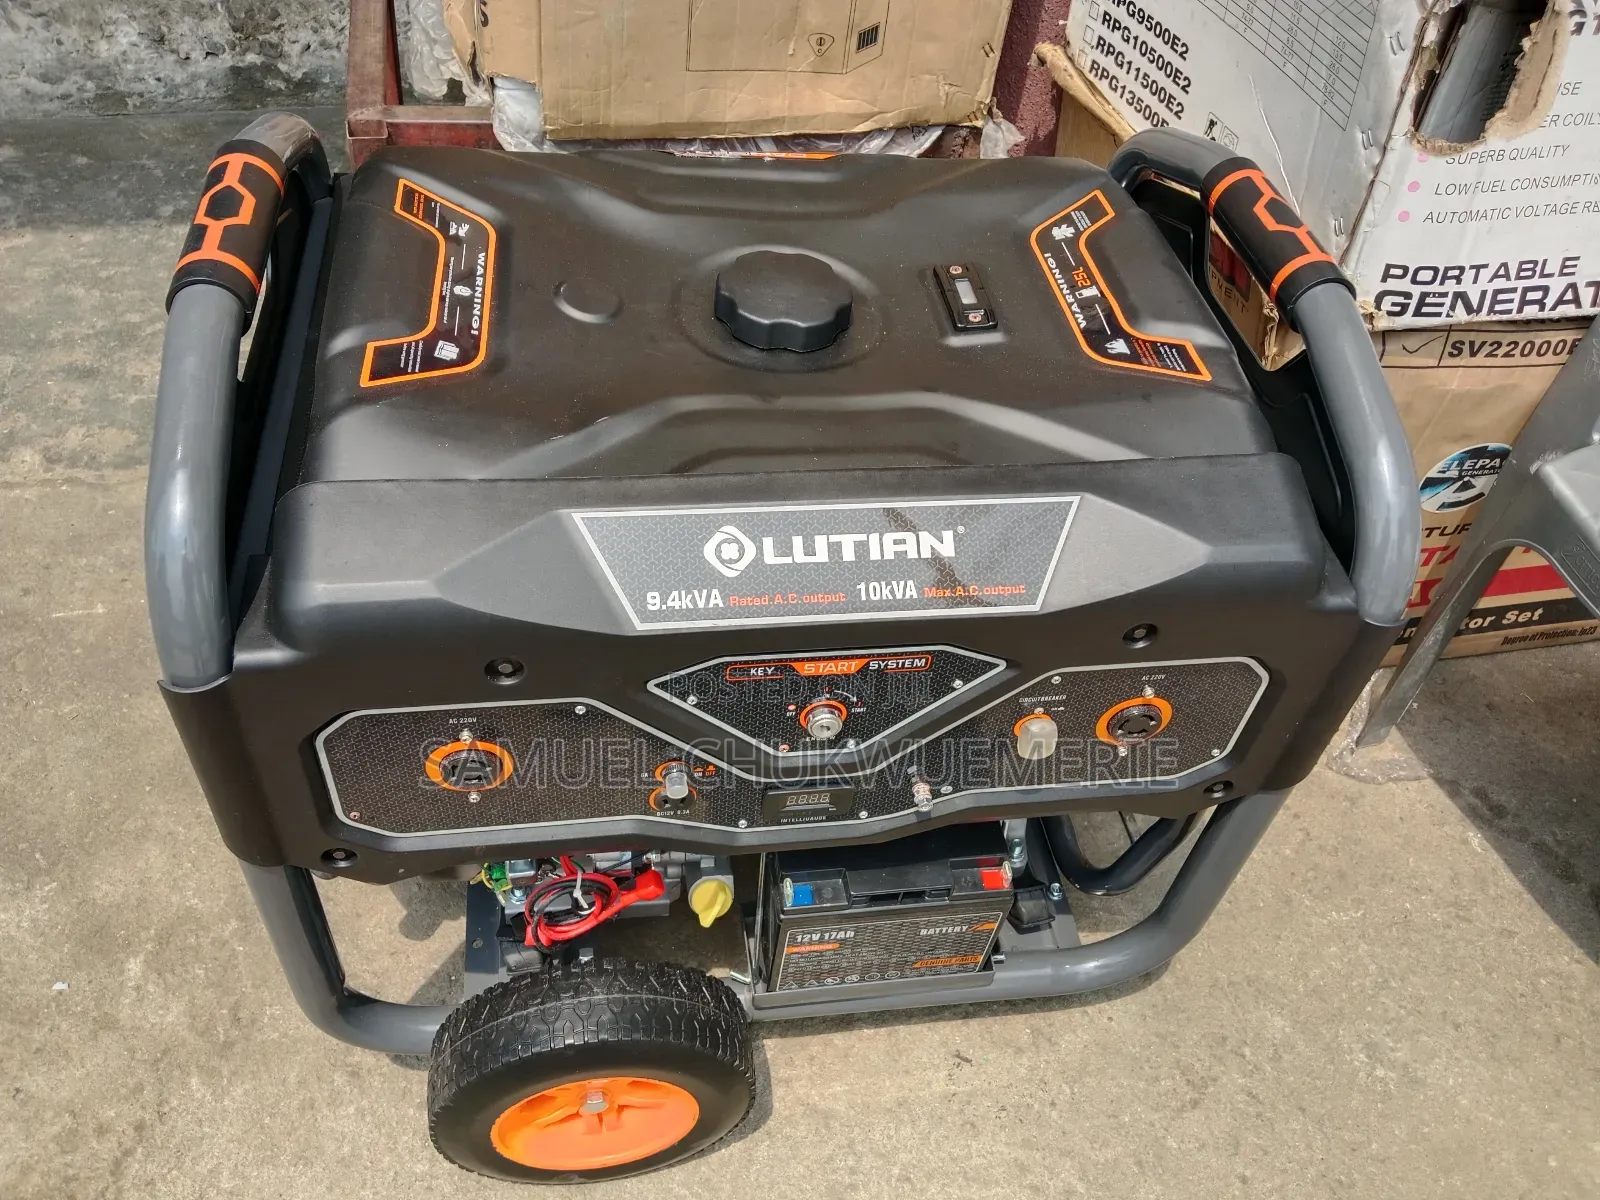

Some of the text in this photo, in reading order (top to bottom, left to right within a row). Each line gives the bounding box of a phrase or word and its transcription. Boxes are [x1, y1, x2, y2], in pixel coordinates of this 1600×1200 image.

[1111, 0, 1190, 61] PG9500E2
[1102, 10, 1192, 95] RPG10500E2
[1096, 35, 1185, 120] RPG11500E2
[1508, 144, 1570, 162] QUALITY
[1434, 182, 1472, 196] LOW
[1473, 179, 1507, 195] FUEL
[1423, 206, 1512, 224] AUTOMATIC
[1514, 201, 1580, 220] VOLTAGE
[1380, 255, 1581, 286] PORTABLE
[470, 252, 486, 335] WARNING!
[1043, 252, 1087, 329] WARNING!
[762, 530, 957, 565] LUTIAN
[646, 588, 725, 611] 9.4kVA
[856, 579, 919, 601] 10kVA
[1502, 606, 1544, 625] Set
[1501, 634, 1530, 646] Degree
[1529, 632, 1539, 642] of
[750, 658, 927, 677] KEY START SYSTEM
[796, 930, 855, 943] 12V 17Ah
[920, 925, 969, 936] BATTERY
[919, 957, 953, 967] GENUINE
[954, 955, 980, 964] PARTS
